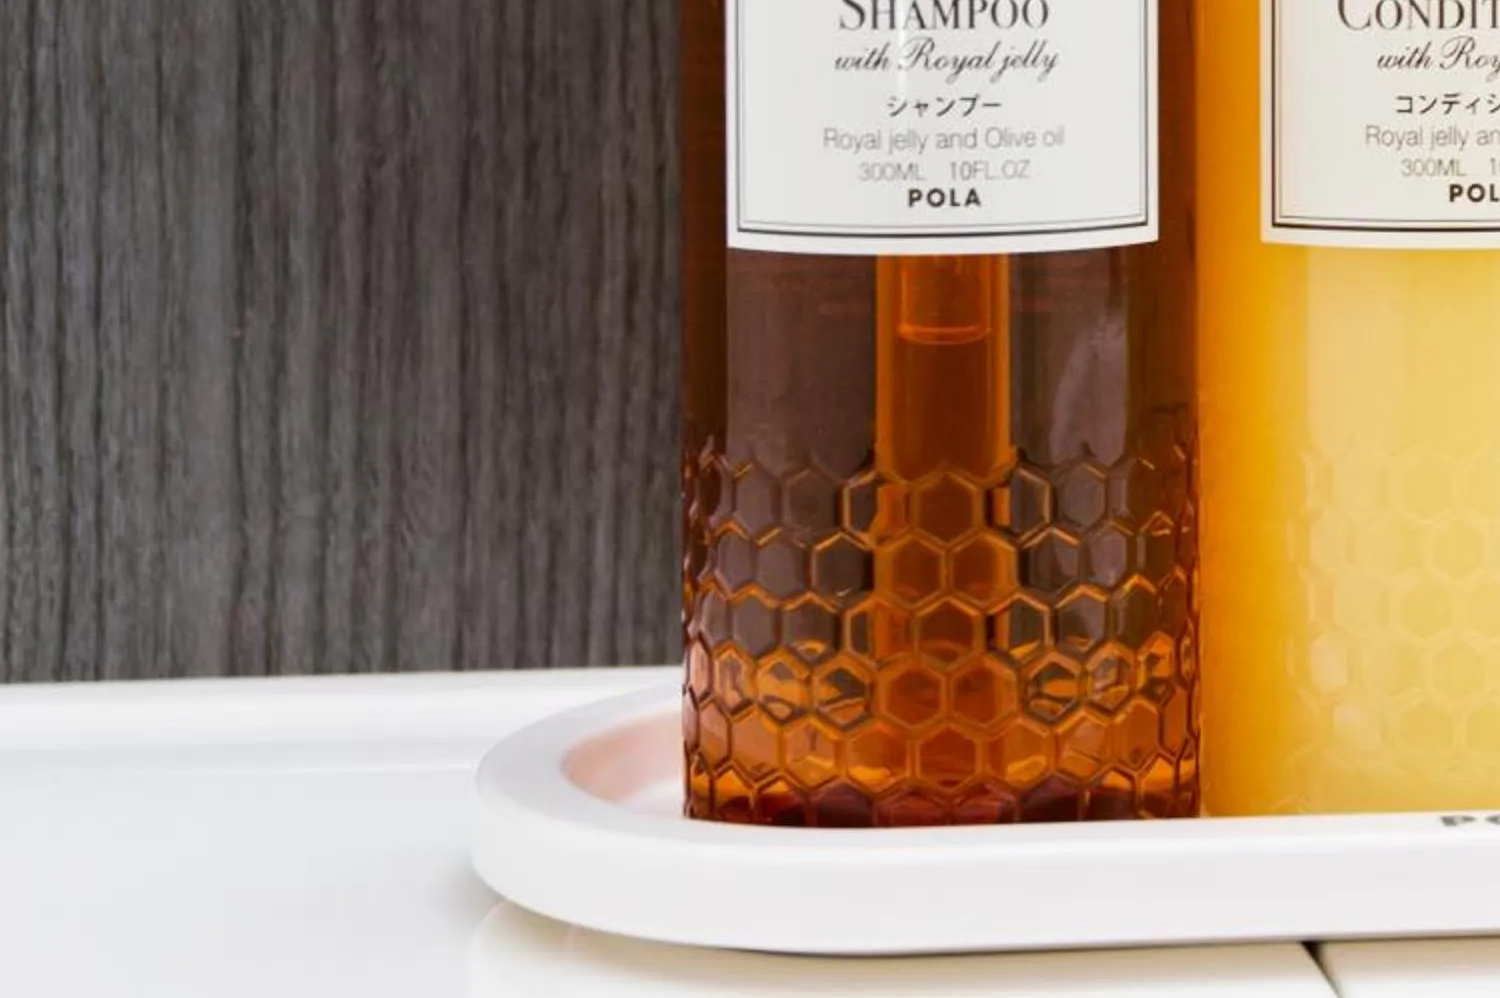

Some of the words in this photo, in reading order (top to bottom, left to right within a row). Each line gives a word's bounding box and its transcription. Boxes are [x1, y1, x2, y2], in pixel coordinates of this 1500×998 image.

[834, 41, 893, 70] with
[897, 36, 995, 82] Royal
[990, 40, 1060, 83] jelly
[1376, 41, 1433, 69] with
[823, 128, 881, 153] Royal
[888, 128, 928, 153] jelly
[935, 127, 977, 149] and
[985, 126, 1037, 149] Olive
[1365, 124, 1423, 150] Royal
[1430, 124, 1469, 150] jelly
[859, 162, 926, 181] 300ML
[1400, 158, 1466, 178] 300ML
[908, 189, 981, 207] POLA
